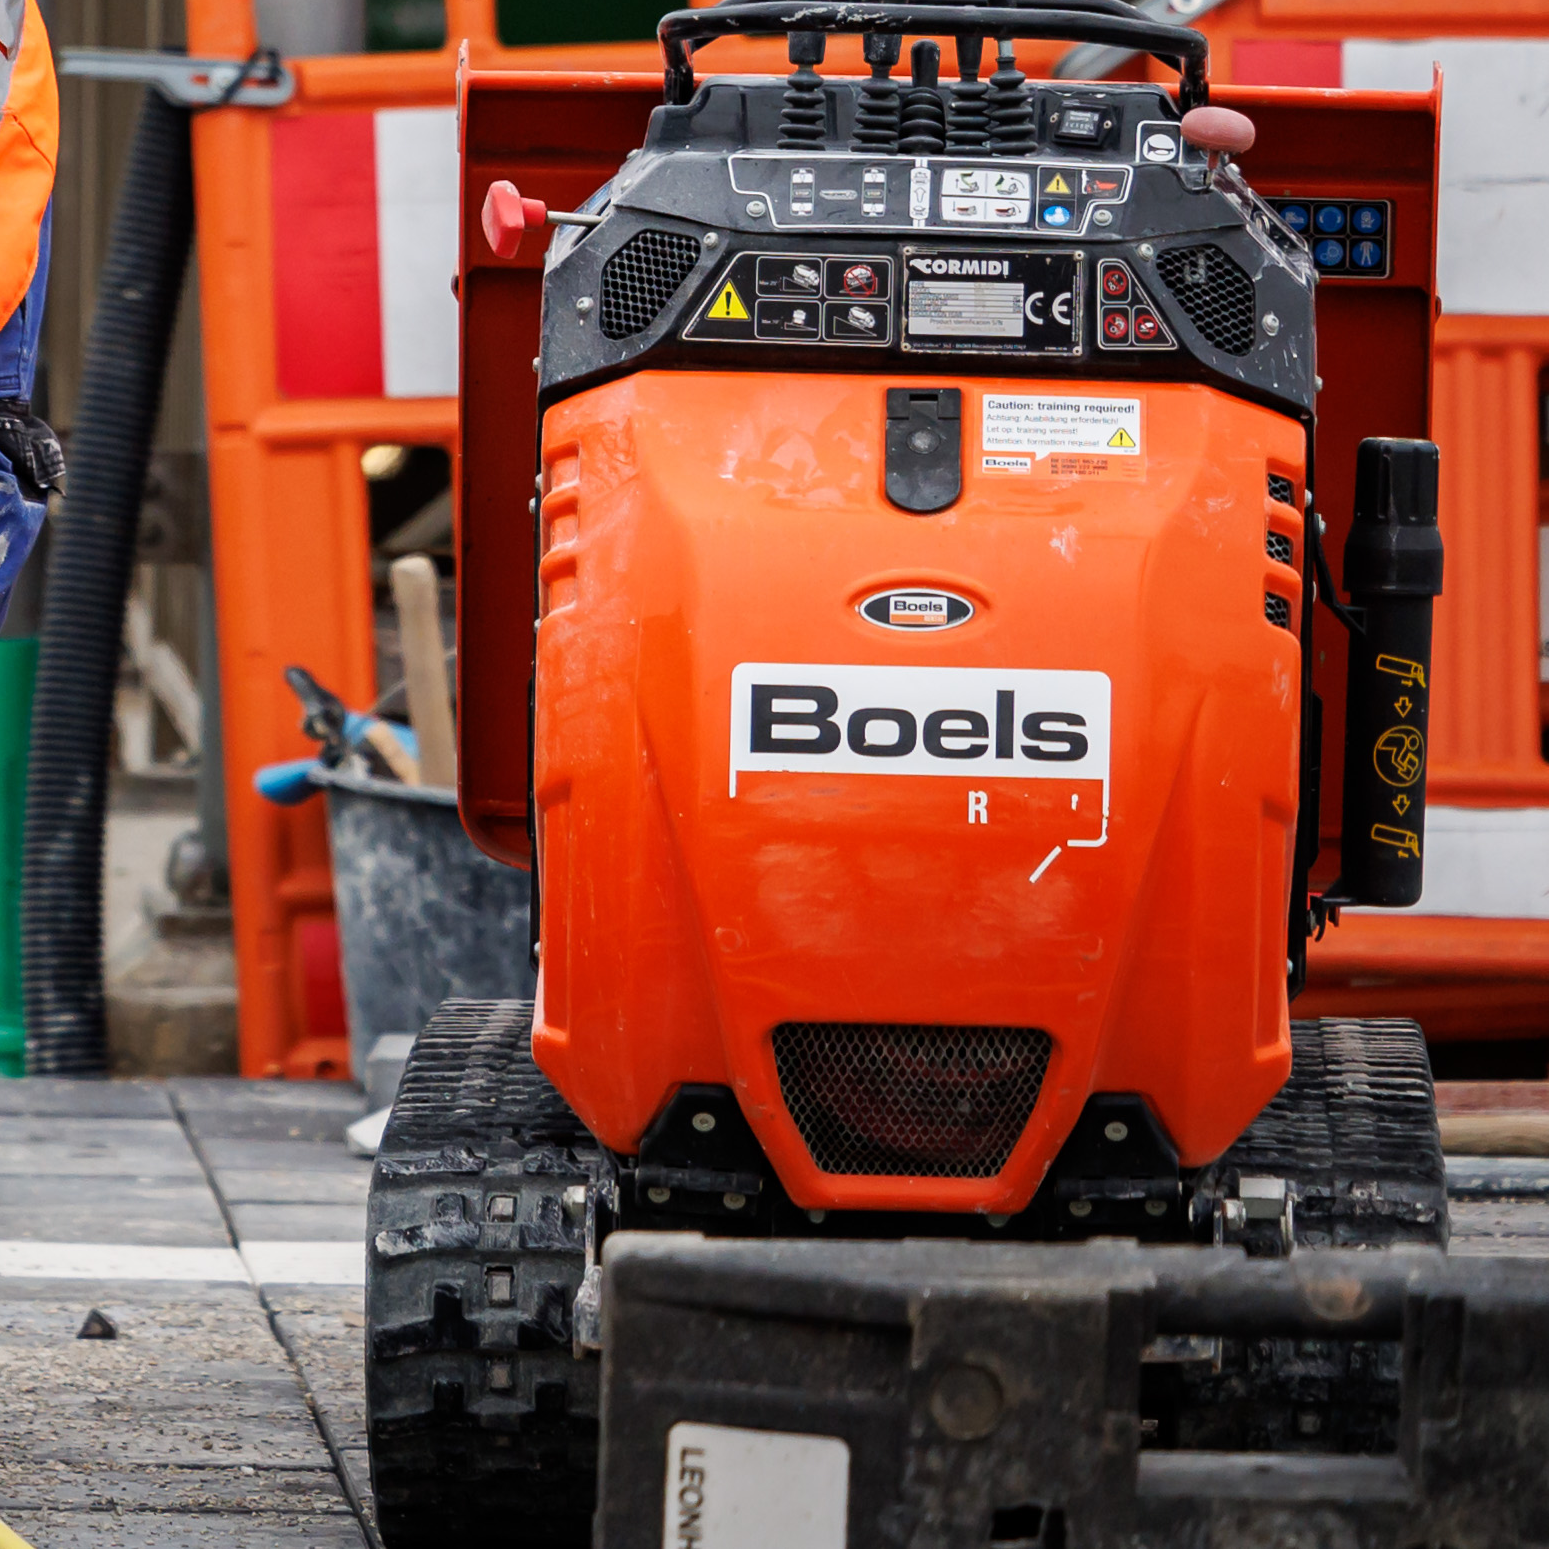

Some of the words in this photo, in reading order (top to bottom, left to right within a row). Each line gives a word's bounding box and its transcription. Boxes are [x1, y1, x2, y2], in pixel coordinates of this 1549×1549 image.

[909, 258, 1010, 276] CORMIDI
[1025, 291, 1072, 325] CE
[988, 400, 1034, 410] Caution:
[1038, 402, 1080, 413] training
[1084, 404, 1135, 414] required!
[987, 414, 1021, 422] Achtung:
[1024, 415, 1068, 424] Ausbildung
[1070, 416, 1119, 425] erforderlich!
[1016, 427, 1047, 435] training
[986, 437, 1023, 445] Attention:
[1026, 438, 1065, 446] formation
[985, 458, 1028, 467] Boels
[894, 600, 943, 612] Boels
[749, 683, 1089, 761] Boels
